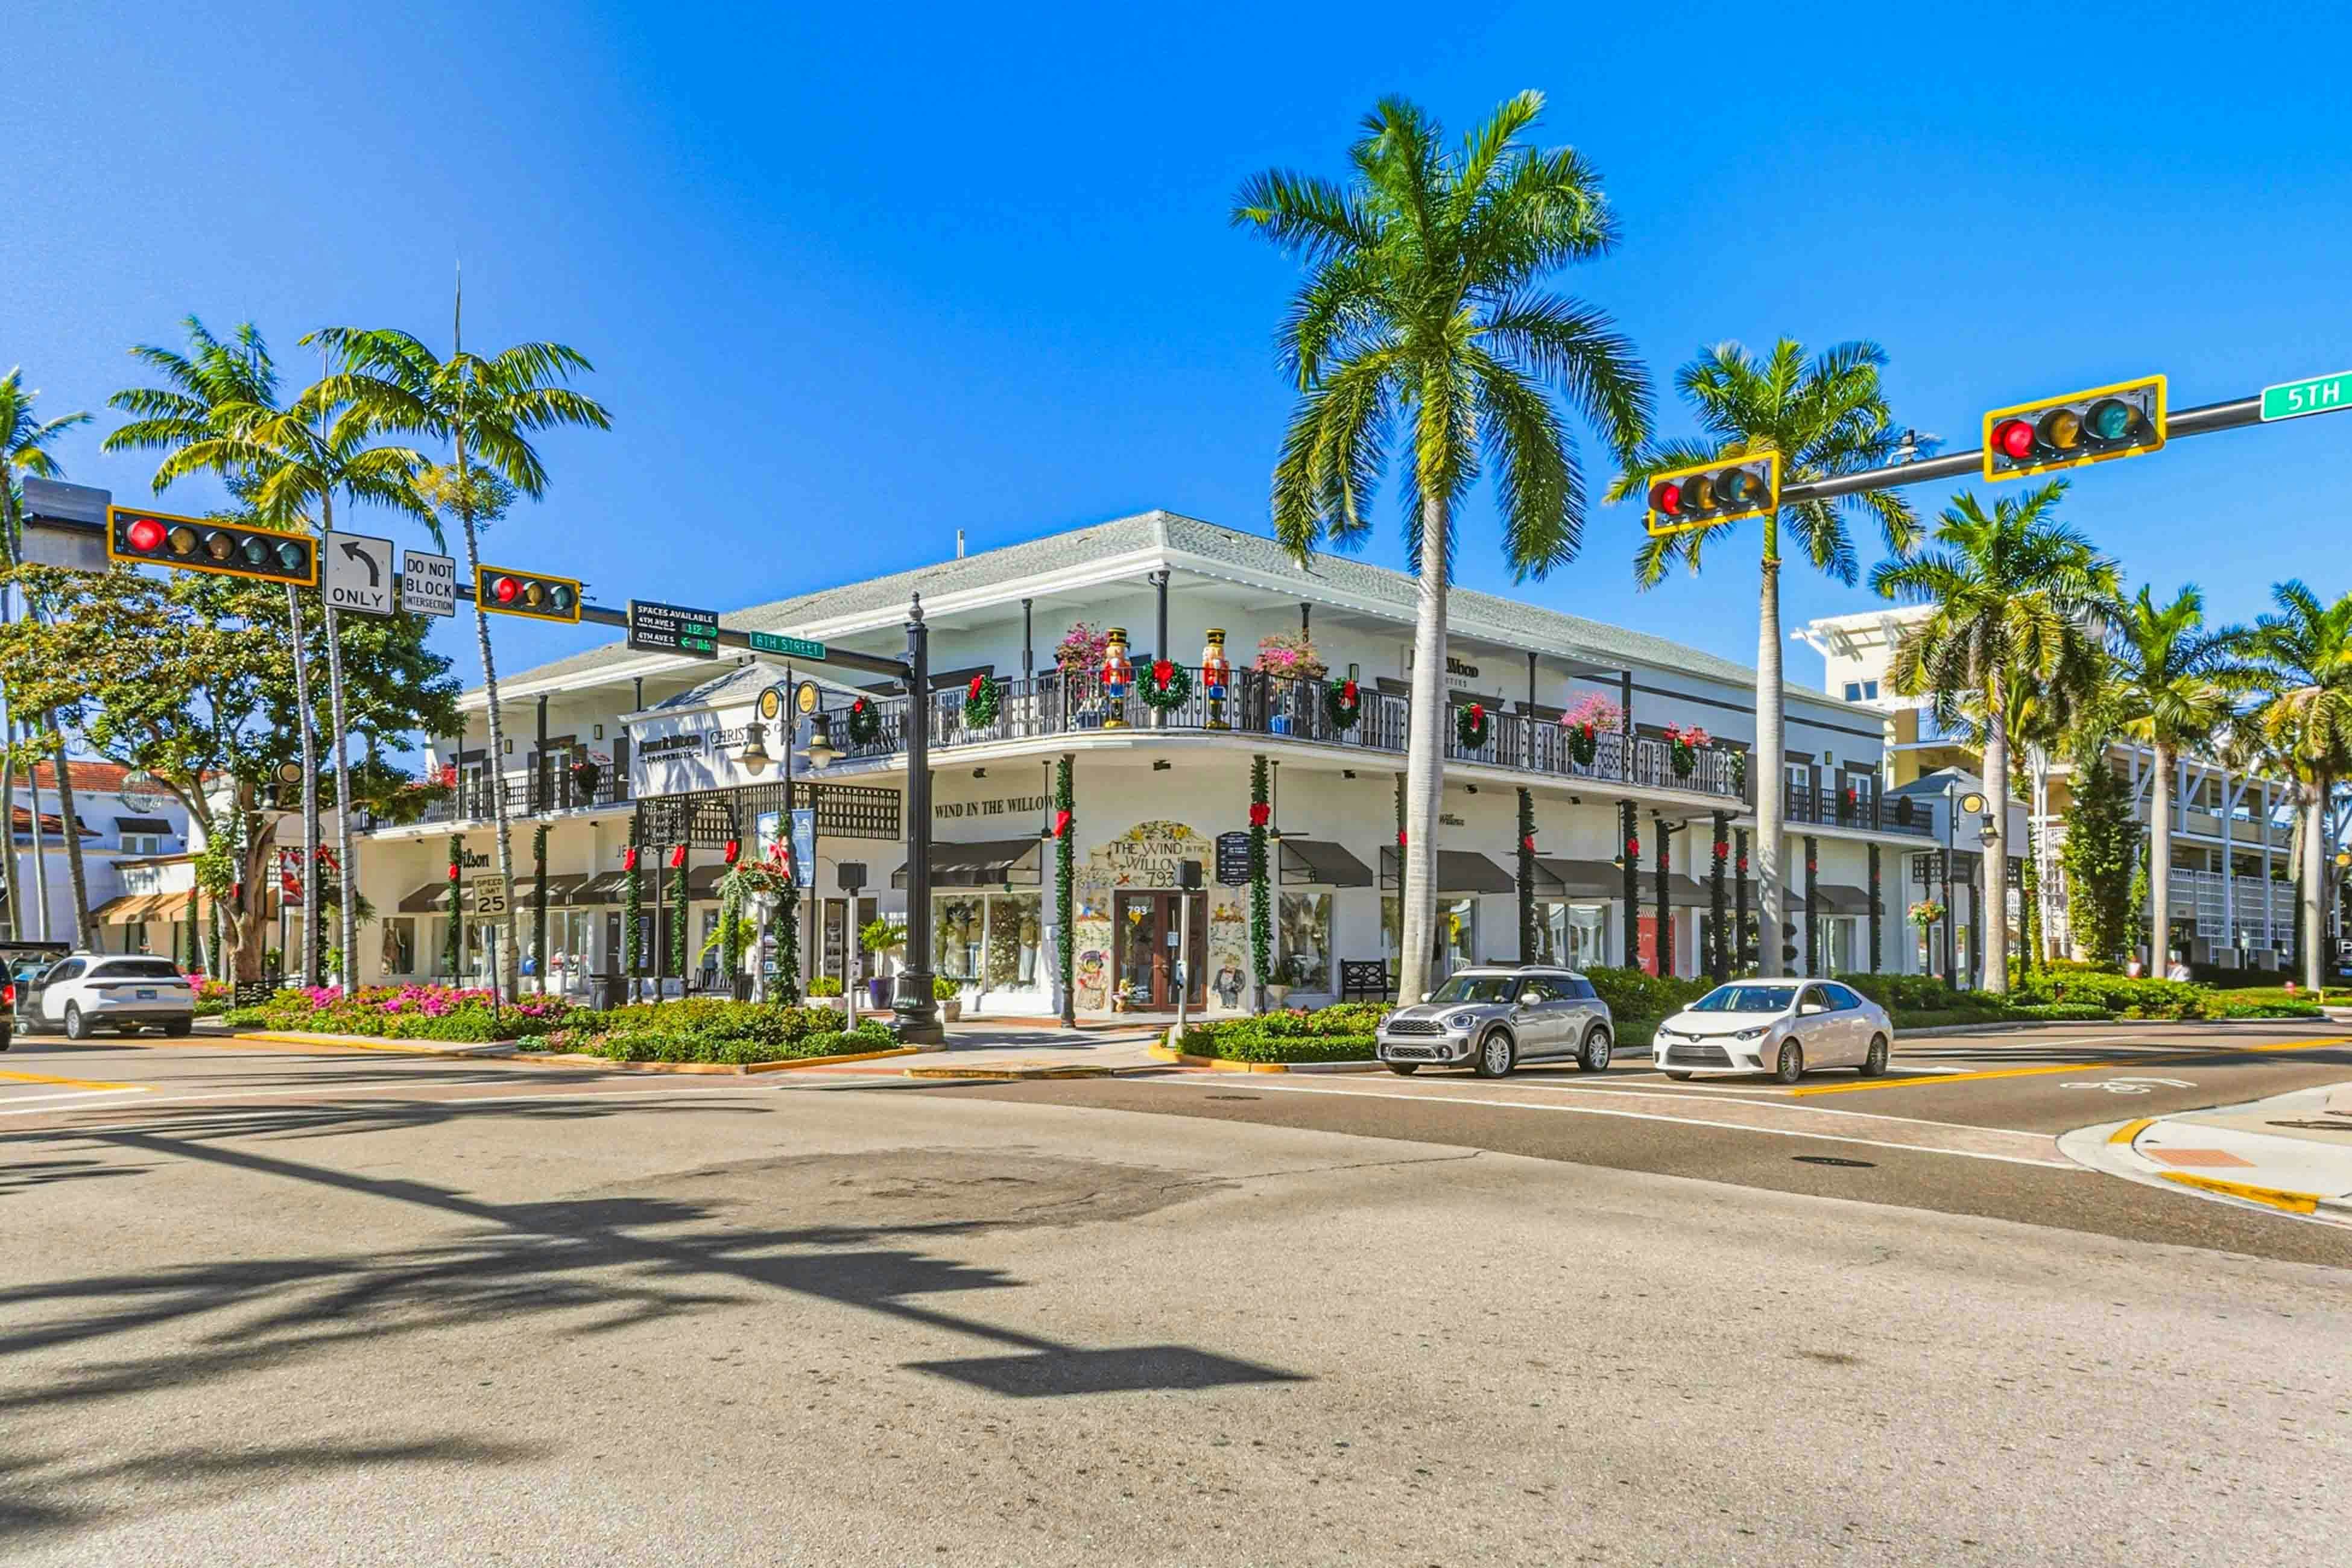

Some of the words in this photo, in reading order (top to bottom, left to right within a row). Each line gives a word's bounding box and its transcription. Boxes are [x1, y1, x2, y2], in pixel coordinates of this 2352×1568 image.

[2288, 381, 2340, 411] 5TH
[407, 558, 424, 574] DO
[429, 563, 453, 579] NOT
[406, 578, 452, 599] BLOCK
[332, 588, 384, 607] ONLY
[405, 596, 452, 611] INTERSECTION
[637, 605, 669, 617] SPACES
[669, 610, 713, 623] AVAILABLE
[654, 618, 669, 627] AVE
[757, 635, 777, 648] 8TH
[781, 639, 818, 656] STREET
[935, 803, 963, 818] WIND
[966, 801, 978, 817] IN
[981, 799, 1004, 815] THE
[1007, 794, 1057, 812] WILLOW
[1113, 841, 1137, 855] THE
[1140, 842, 1183, 855] WIND
[477, 878, 503, 887] SPEED
[1145, 871, 1175, 888] 793
[480, 887, 500, 896] LIMIT
[478, 896, 505, 912] 25
[1127, 906, 1148, 915] 793
